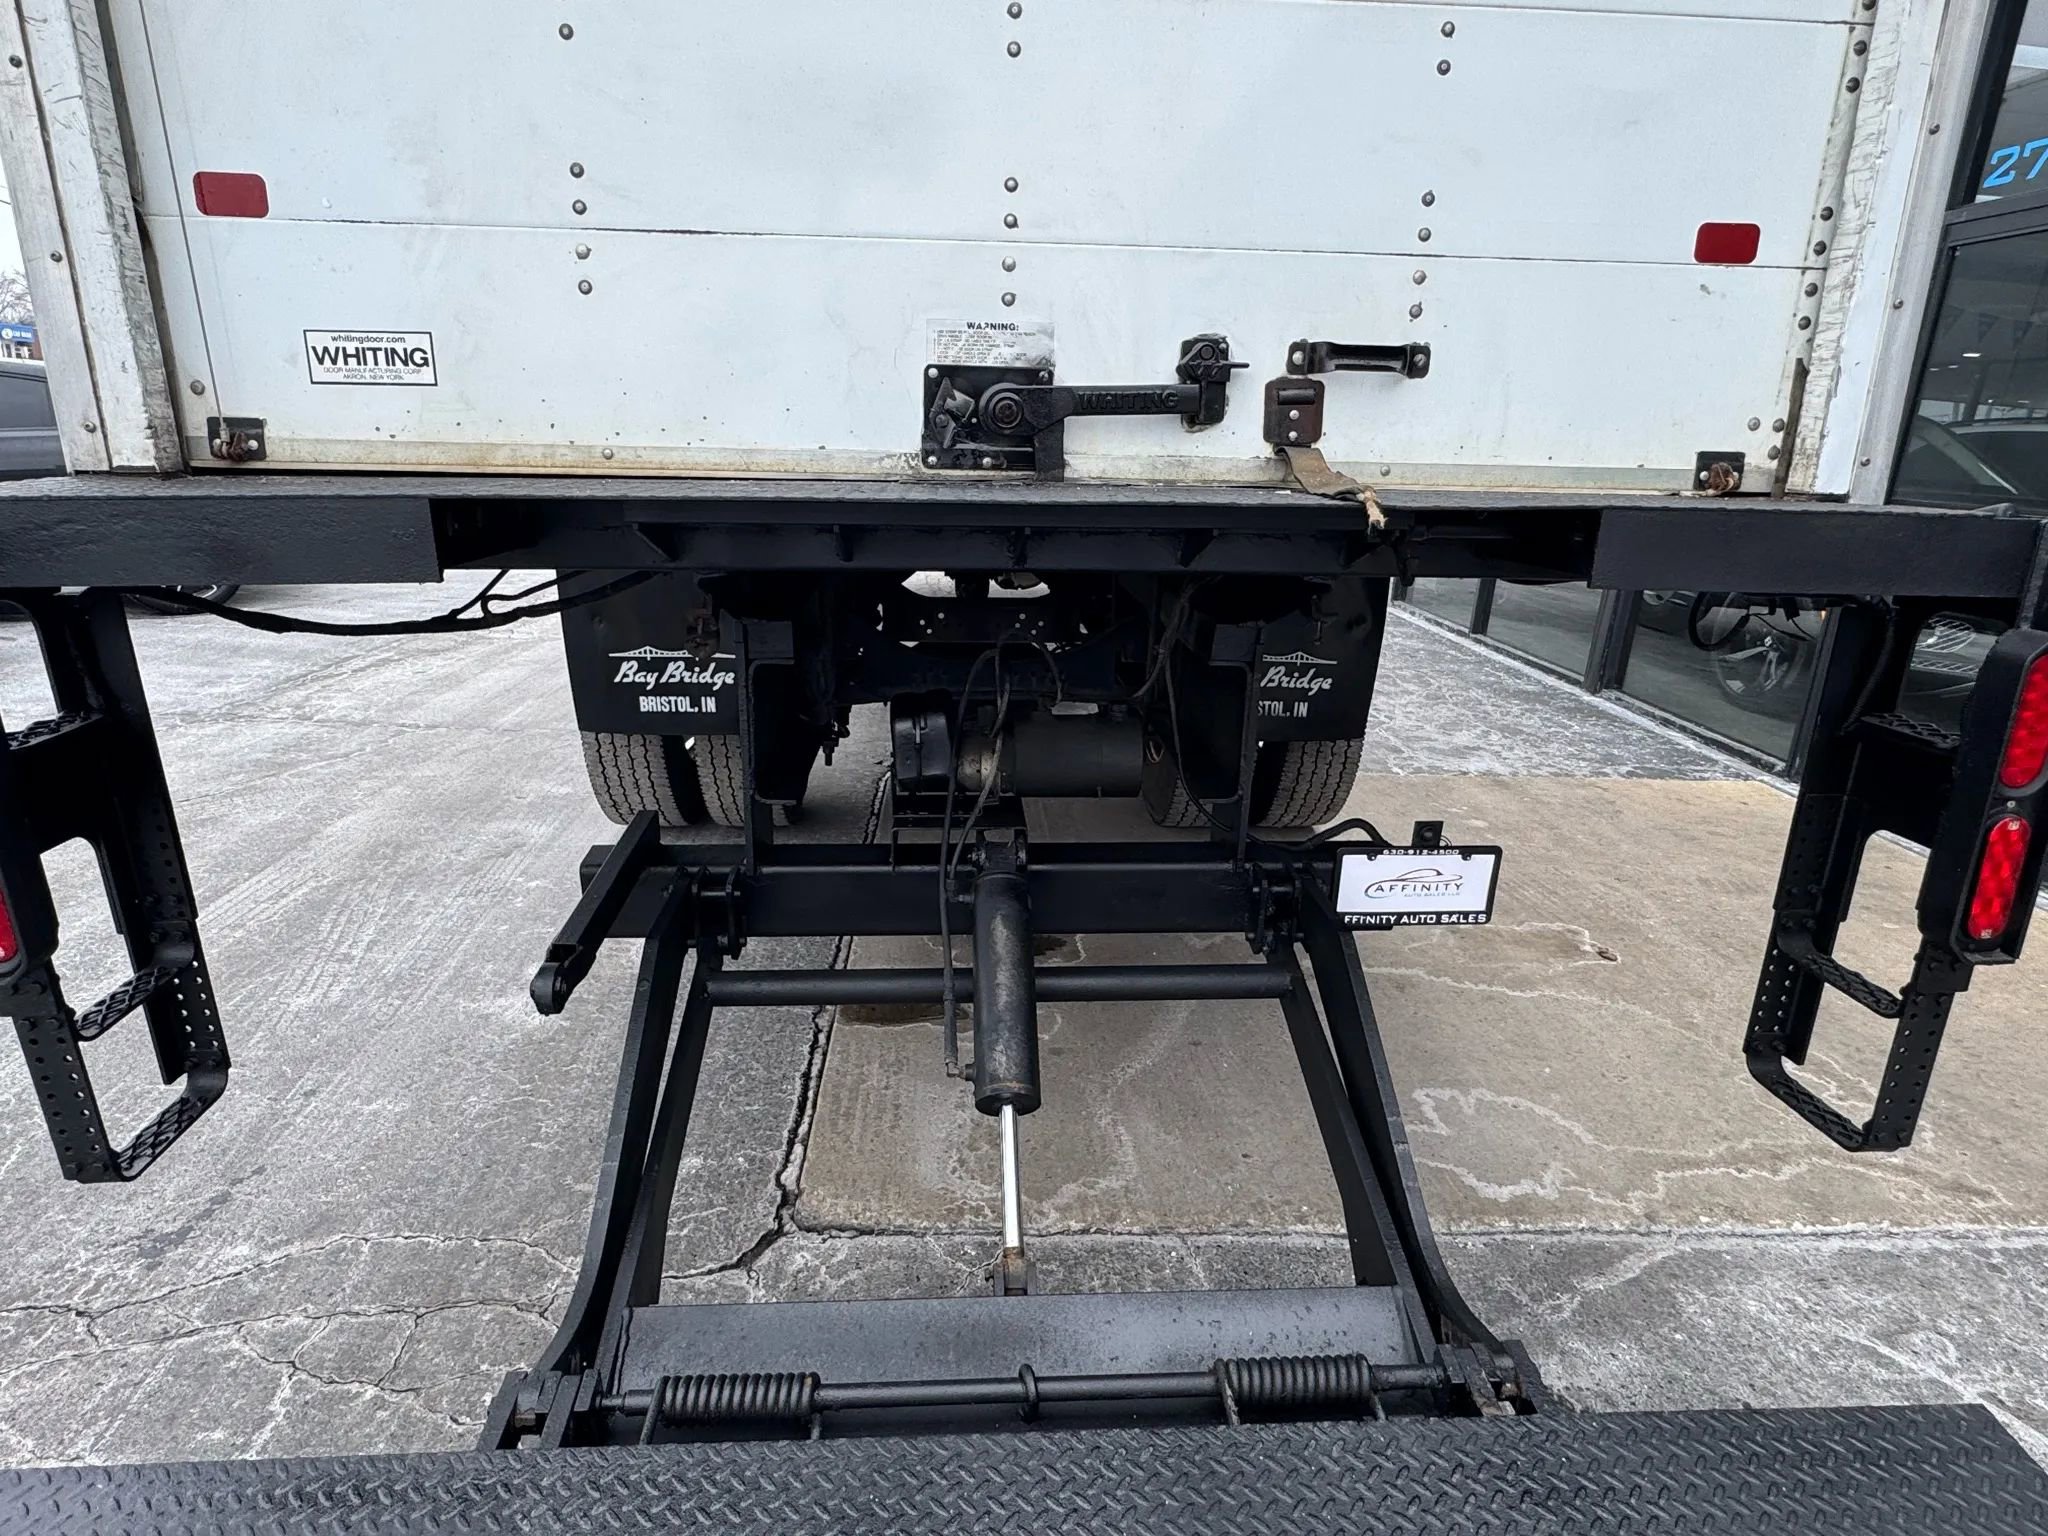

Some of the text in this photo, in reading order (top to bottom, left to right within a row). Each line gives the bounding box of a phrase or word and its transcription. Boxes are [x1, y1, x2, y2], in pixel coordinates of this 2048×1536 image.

[330, 333, 406, 345] whitingdoor.com
[311, 346, 430, 368] WHITING
[344, 367, 403, 375] MANUFACTURING
[1077, 390, 1179, 410] WHITING
[614, 658, 736, 691] Bay Bridge
[1260, 665, 1333, 696] Bridge
[639, 696, 717, 713] BRISTOL, IN
[1293, 702, 1309, 717] IN
[1373, 882, 1465, 893] AFFINITY
[1400, 914, 1437, 924] AUTO
[1440, 913, 1488, 924] SALES
